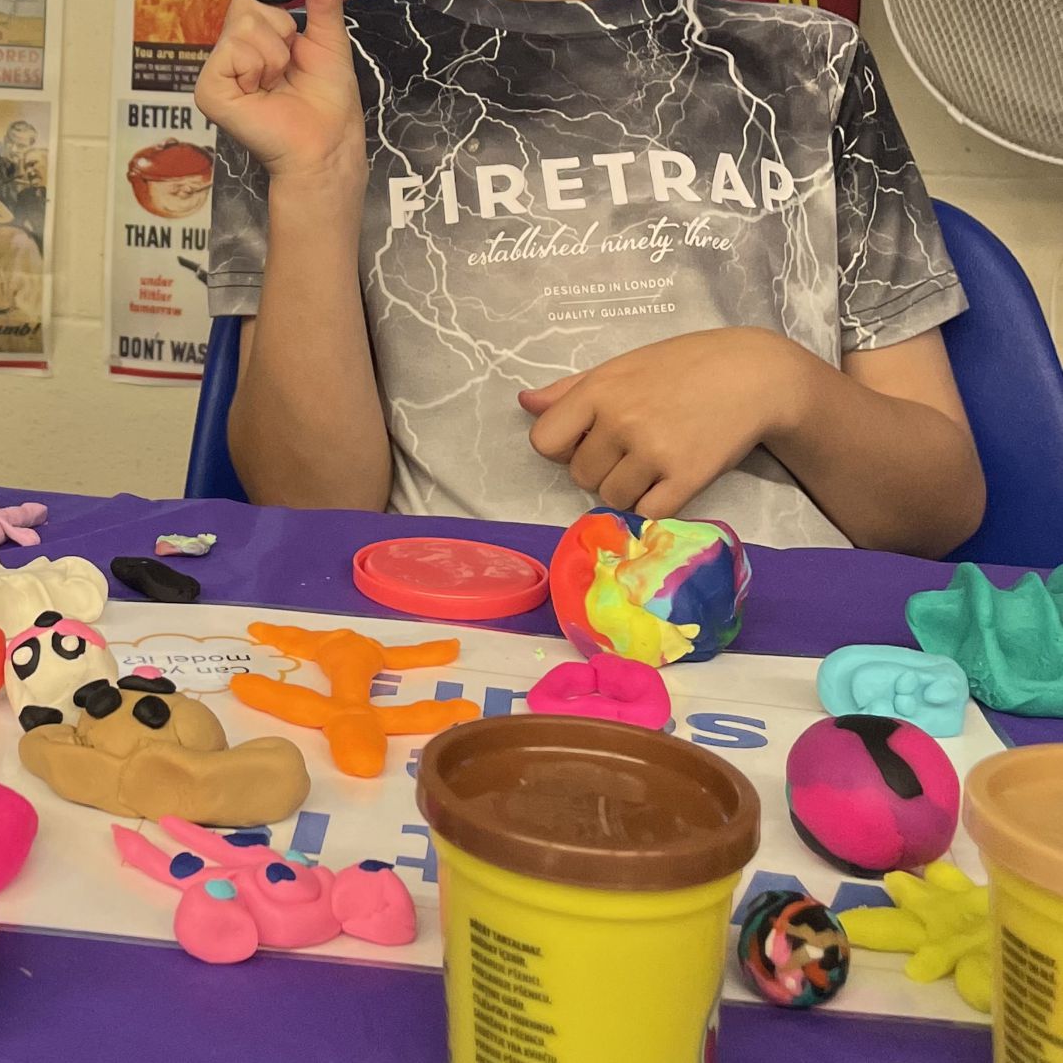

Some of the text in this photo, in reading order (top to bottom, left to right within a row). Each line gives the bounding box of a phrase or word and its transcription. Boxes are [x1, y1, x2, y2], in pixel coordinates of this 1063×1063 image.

[134, 46, 154, 58] You
[128, 103, 193, 131] BETTER
[387, 149, 796, 231] FIRETRAP
[125, 223, 172, 250] THAN
[467, 216, 734, 267] established ninety three
[543, 277, 675, 297] DESIGNED IN LONDON
[547, 302, 677, 322] QUALITY GUARANTEED
[119, 332, 165, 361] DON'T
[165, 653, 252, 665] model
